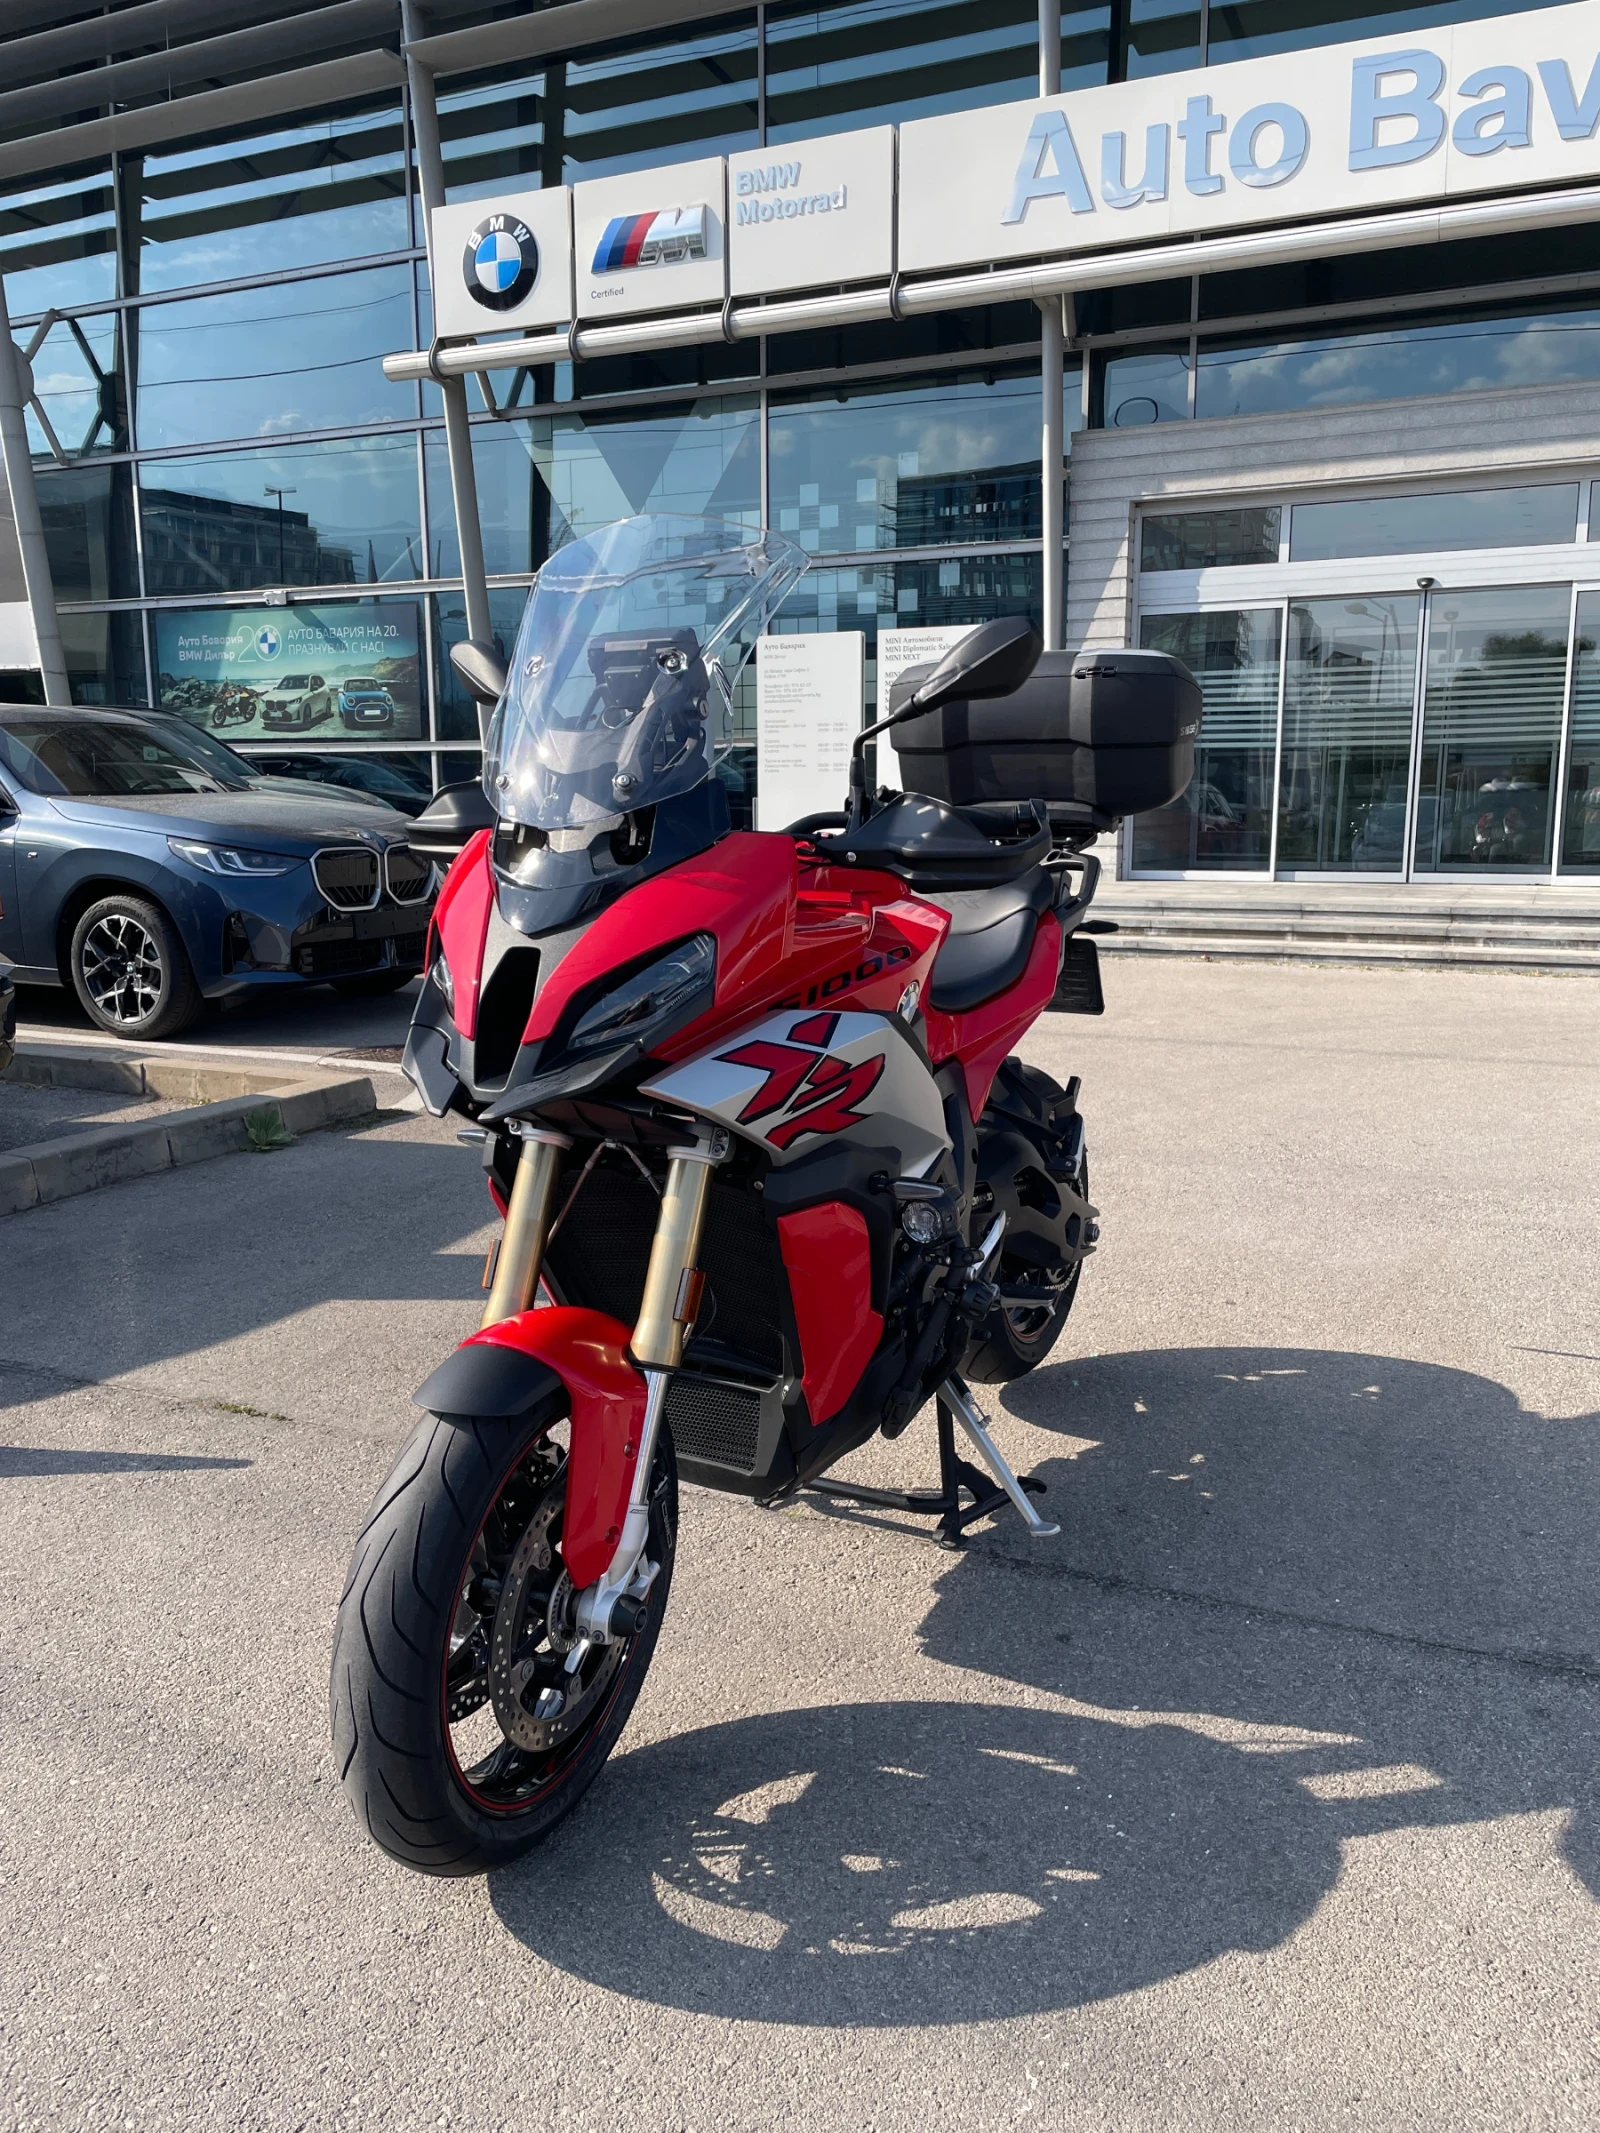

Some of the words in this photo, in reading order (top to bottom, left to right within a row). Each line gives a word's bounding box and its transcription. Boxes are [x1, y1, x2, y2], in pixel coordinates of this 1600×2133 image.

[1000, 94, 1309, 225] Auto
[736, 161, 801, 196] BMW
[736, 184, 847, 226] Motorrad
[468, 216, 530, 250] BMW
[591, 286, 624, 299] Certified
[287, 628, 314, 640] АУТО
[316, 626, 364, 639] БАВАРИЯ
[367, 625, 382, 637] НА
[384, 625, 399, 637] 20.
[178, 636, 200, 648] Ауто
[202, 635, 243, 646] Бавария
[289, 640, 348, 655] ПРАЗНУВАЙ
[351, 642, 358, 653] С
[361, 641, 384, 653] НАС!
[764, 643, 779, 651] Ауто
[780, 643, 806, 651] Бавария
[903, 645, 937, 653] Diplomatic
[179, 651, 202, 662] BMW
[204, 650, 235, 662] Дилър
